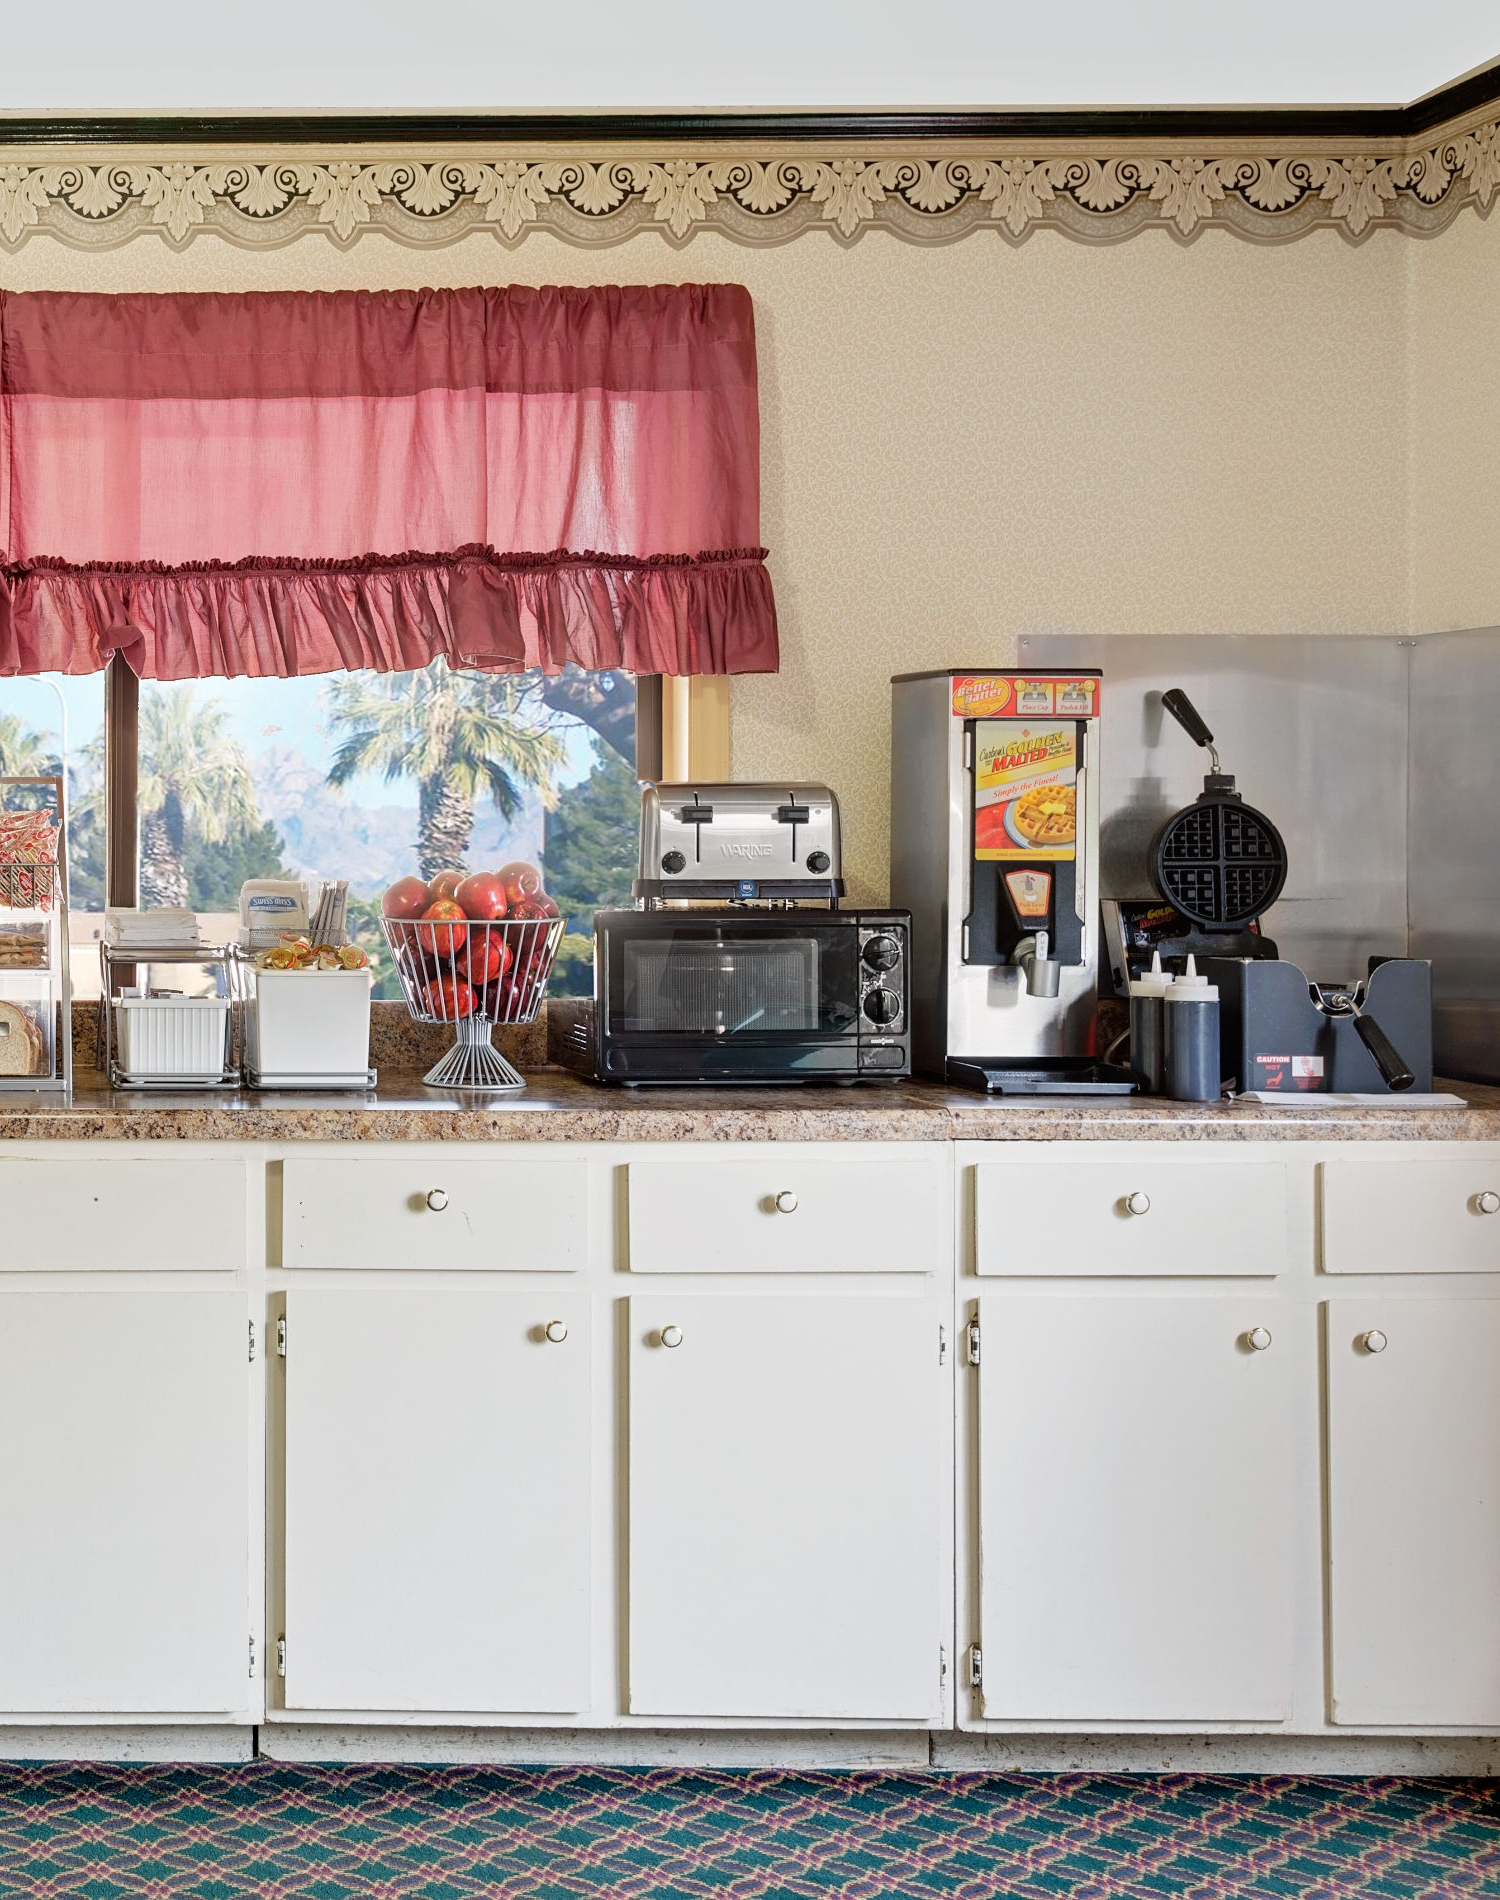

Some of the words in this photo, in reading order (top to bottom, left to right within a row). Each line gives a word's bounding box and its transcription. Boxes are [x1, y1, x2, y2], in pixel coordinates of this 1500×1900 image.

[957, 680, 996, 696] Better
[965, 687, 1003, 704] Batter
[1006, 731, 1063, 756] GOLDEN
[991, 748, 1048, 772] MALTED
[993, 787, 1019, 799] Simply
[1020, 782, 1032, 791] the
[1033, 774, 1059, 787] Finest!
[721, 844, 773, 860] WARING
